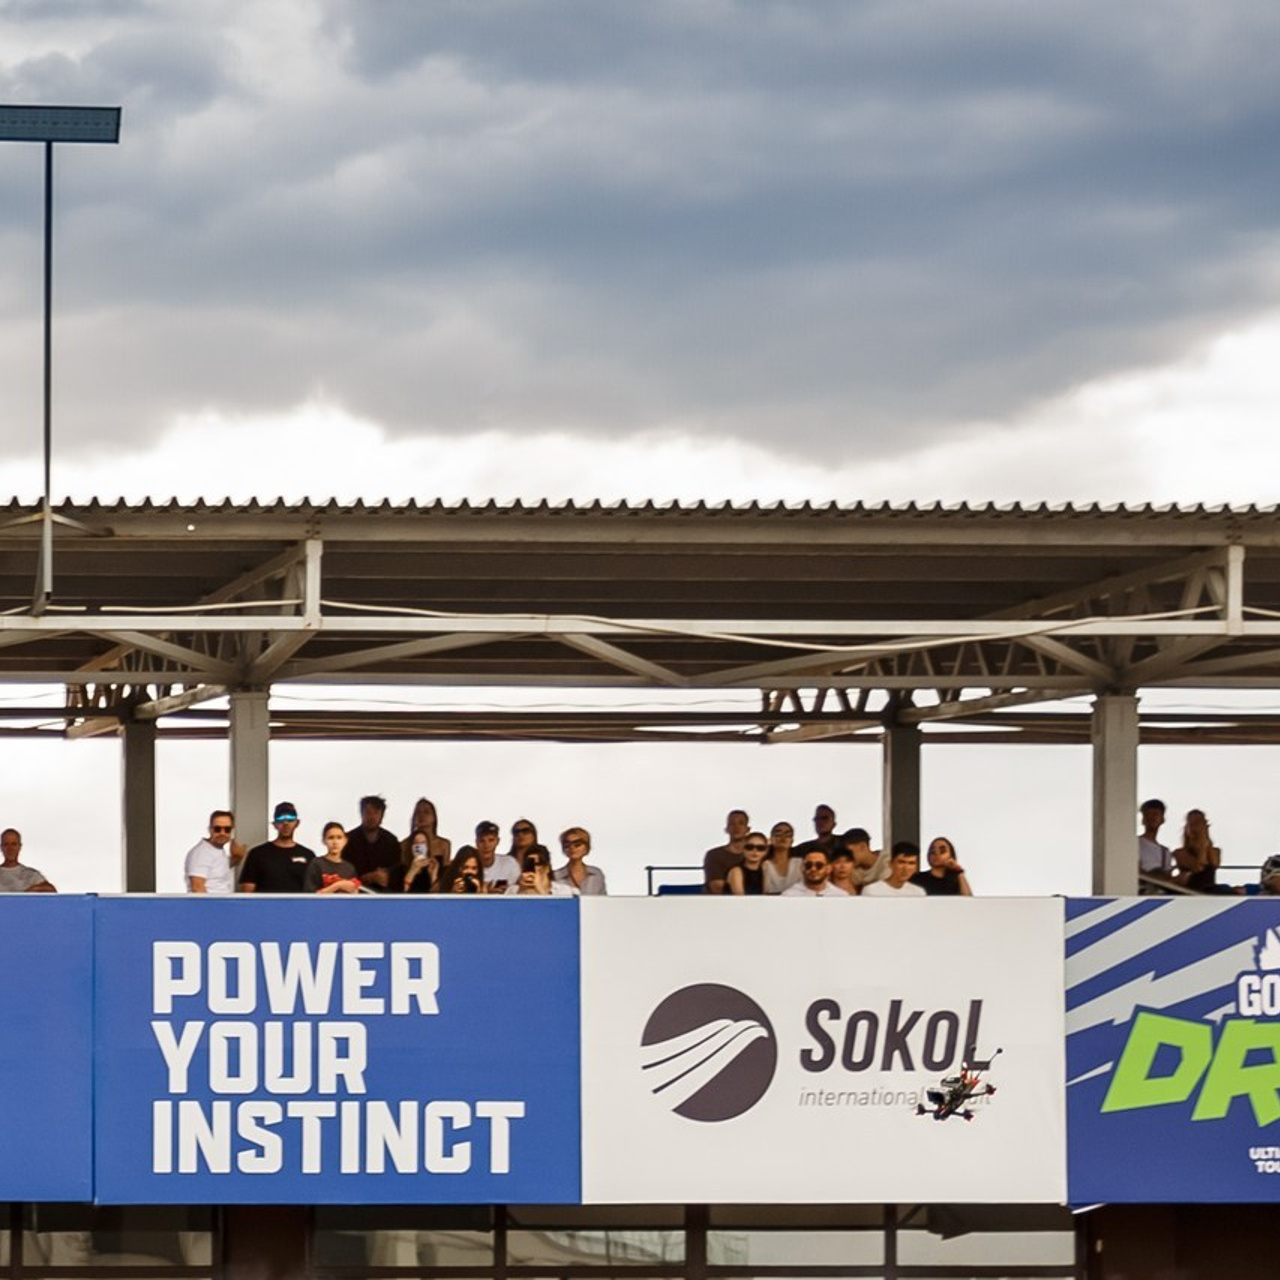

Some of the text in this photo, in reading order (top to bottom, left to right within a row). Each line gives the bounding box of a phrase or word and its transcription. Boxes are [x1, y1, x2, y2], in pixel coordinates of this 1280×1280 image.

[153, 941, 440, 1015] POWER
[151, 1021, 367, 1094] YOUR
[798, 1086, 925, 1106] international
[152, 1101, 525, 1174] INSTINCT
